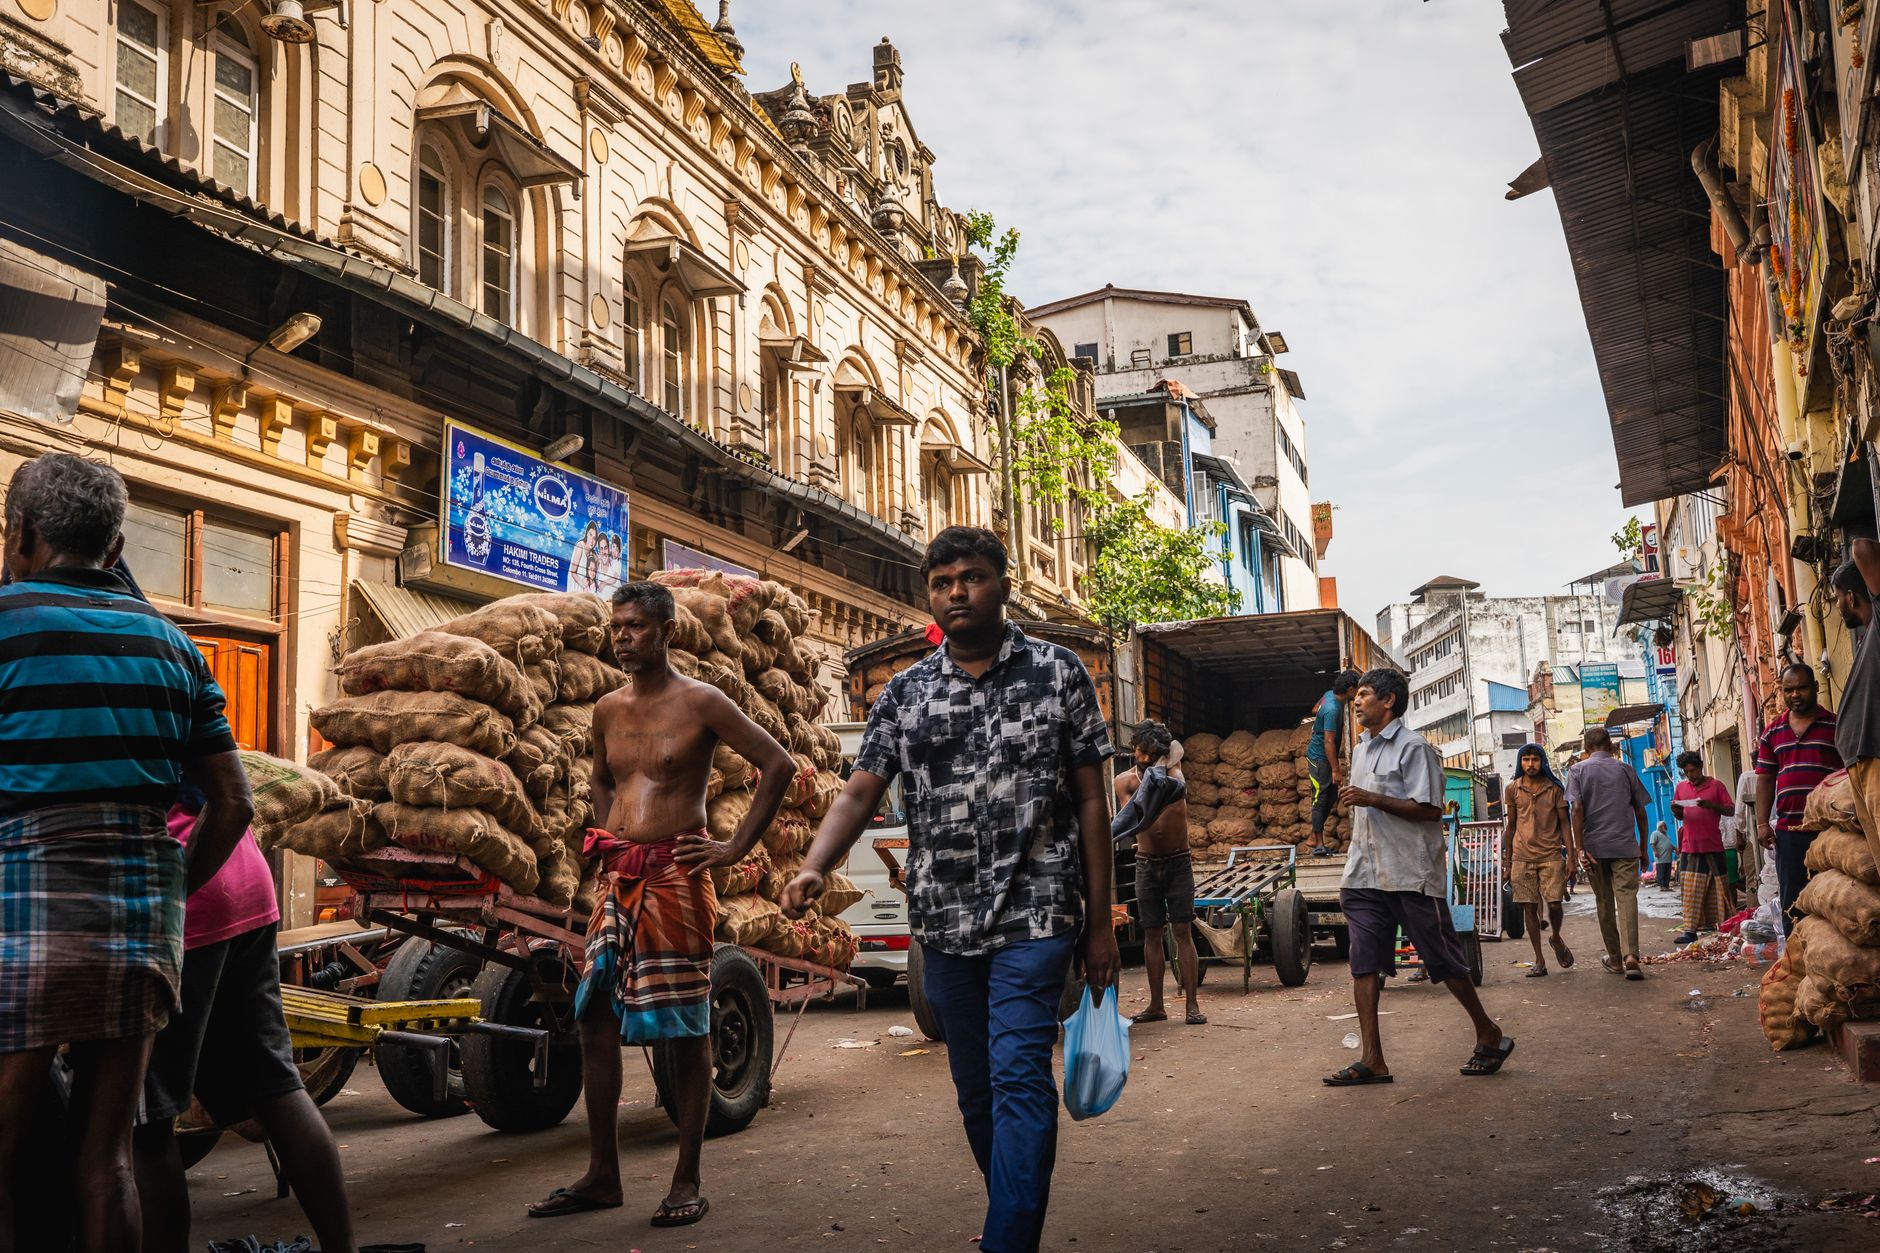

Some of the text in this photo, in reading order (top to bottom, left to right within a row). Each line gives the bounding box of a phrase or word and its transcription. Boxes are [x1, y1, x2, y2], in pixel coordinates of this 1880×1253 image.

[503, 544, 559, 570] HAKIMI TRADERS
[502, 564, 522, 576] Colombo
[520, 561, 535, 571] Fourth
[534, 565, 546, 575] Cross
[546, 569, 559, 579] Street,
